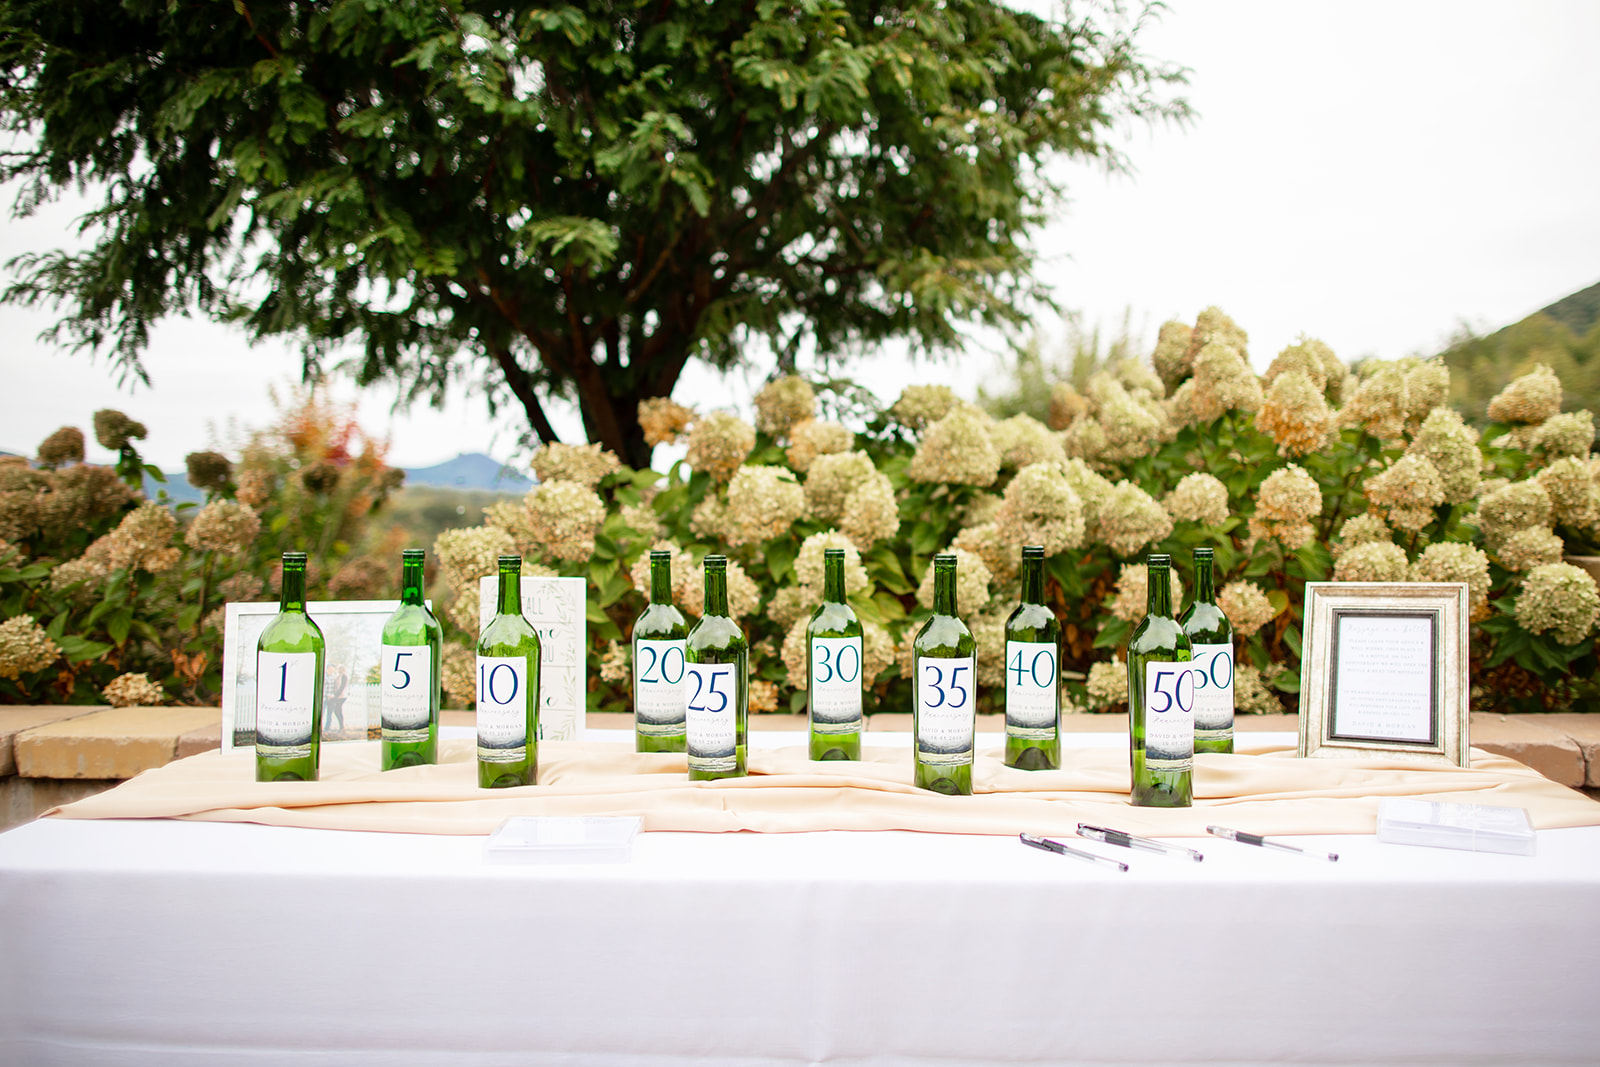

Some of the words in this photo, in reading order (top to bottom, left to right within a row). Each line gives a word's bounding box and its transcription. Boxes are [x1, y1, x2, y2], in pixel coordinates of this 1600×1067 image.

[277, 661, 289, 702] 1
[391, 652, 413, 690] 5
[480, 663, 519, 705] 10
[639, 646, 685, 684] 20
[815, 645, 859, 683] 30
[1008, 649, 1055, 688] 40
[687, 669, 729, 713] 25
[924, 665, 969, 709] 35
[1150, 669, 1194, 713] 50
